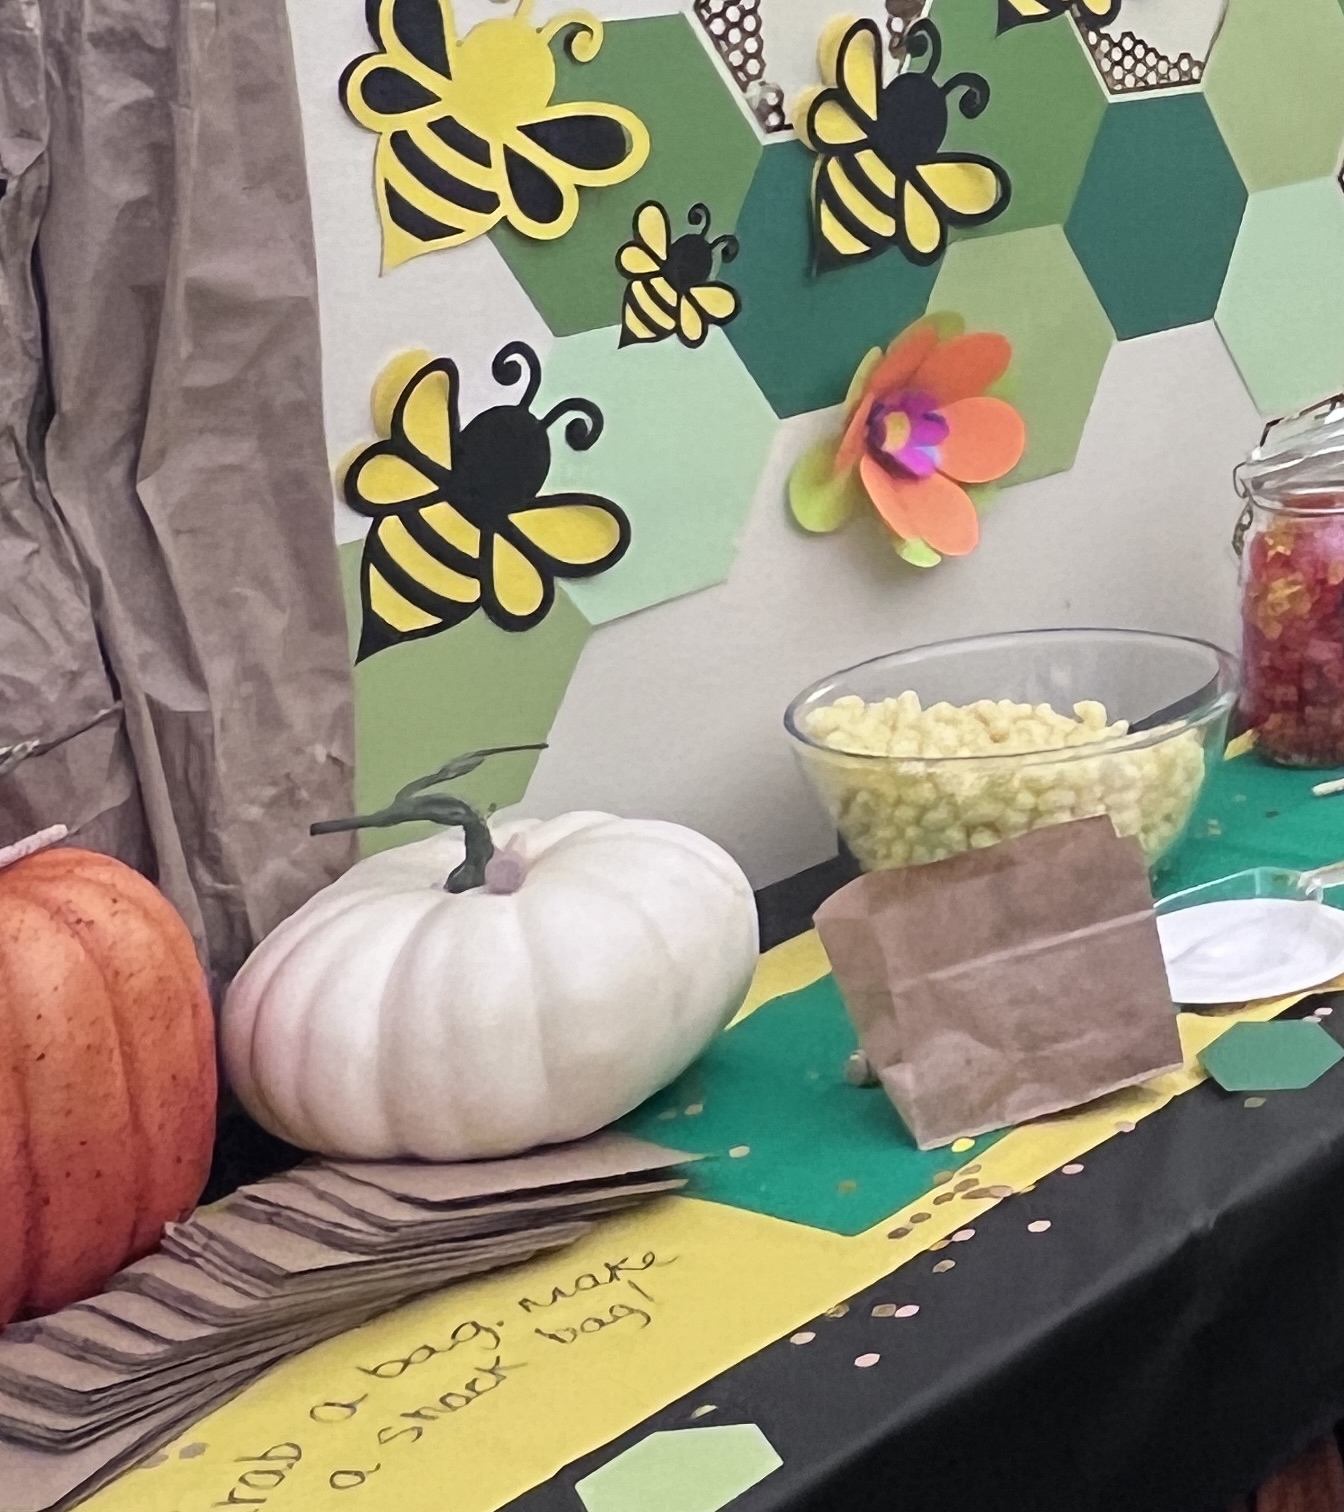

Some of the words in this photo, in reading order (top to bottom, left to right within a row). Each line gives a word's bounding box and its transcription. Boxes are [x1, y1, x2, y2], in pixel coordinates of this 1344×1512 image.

[212, 1442, 303, 1512] rab
[309, 1393, 369, 1423] a
[329, 1462, 382, 1490] a
[377, 1354, 529, 1445] snack
